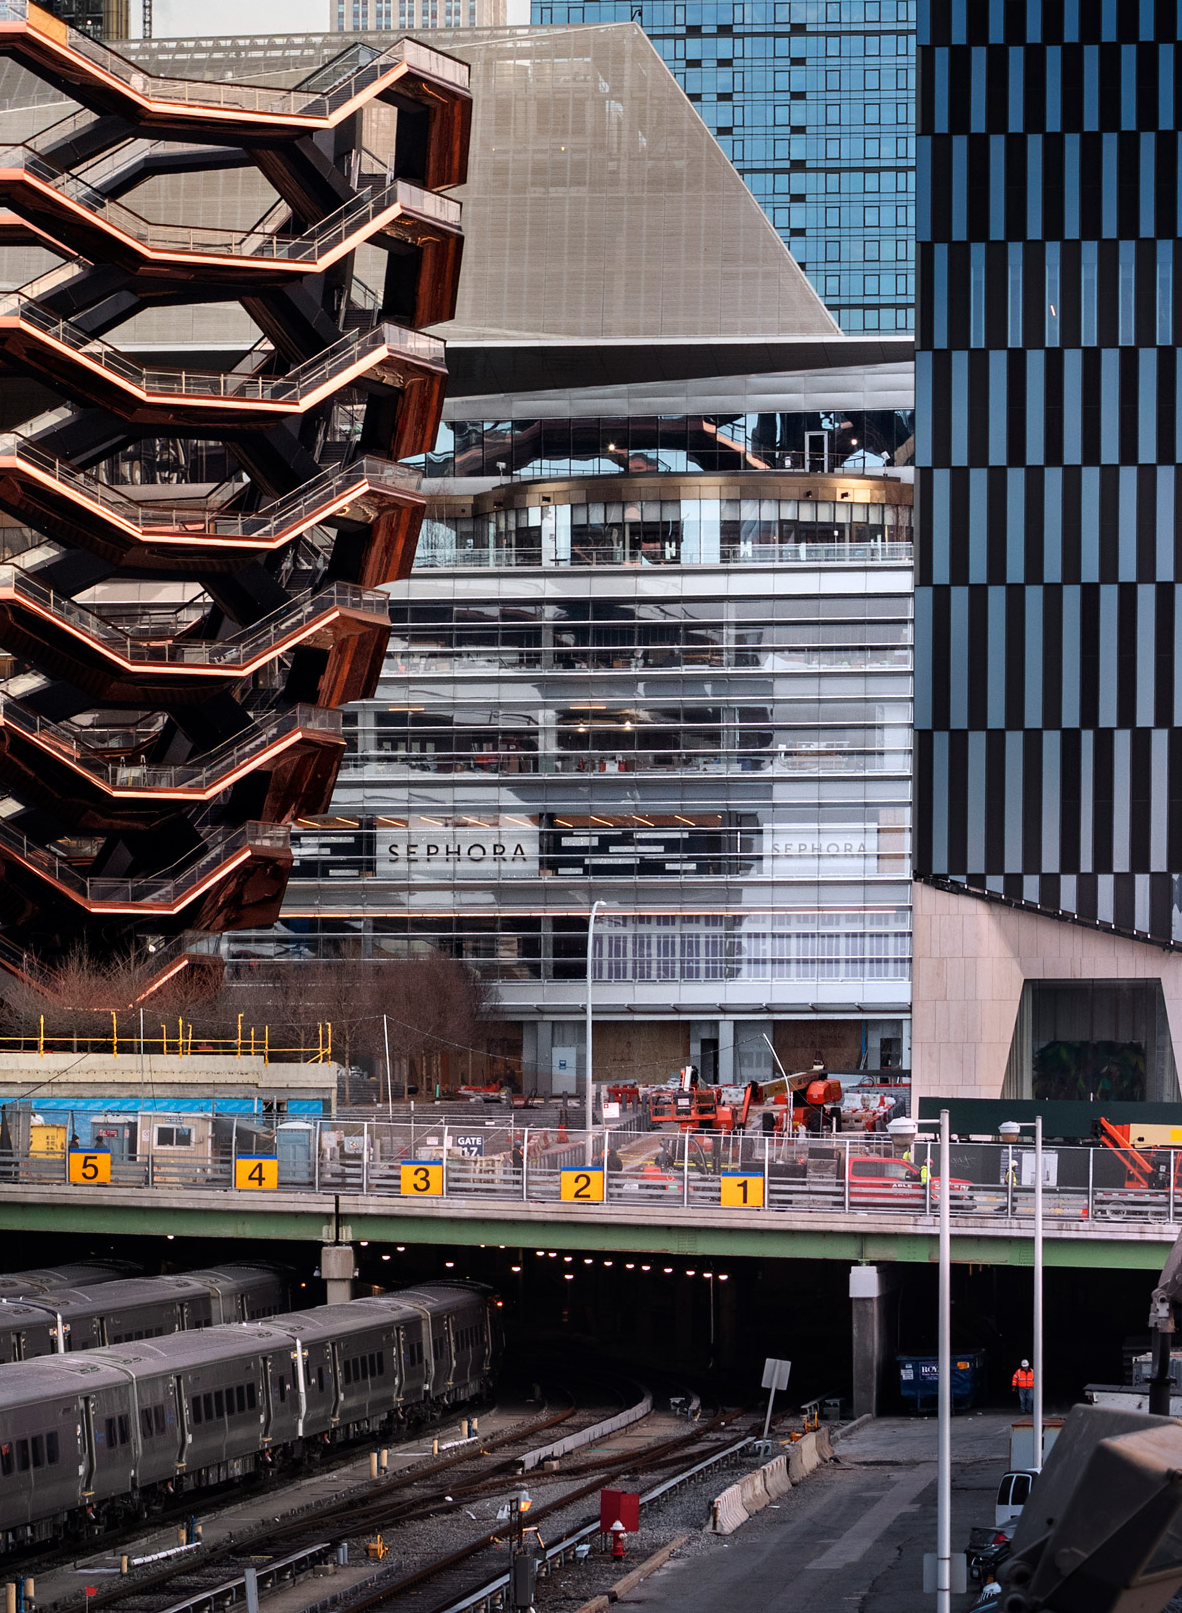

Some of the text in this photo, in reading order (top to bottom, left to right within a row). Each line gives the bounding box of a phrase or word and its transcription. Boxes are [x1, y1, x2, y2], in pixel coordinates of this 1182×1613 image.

[388, 843, 527, 863] SEPHORA
[772, 842, 867, 858] SEPHORA
[458, 1137, 482, 1145] GATE
[462, 1147, 478, 1156] 17
[81, 1156, 99, 1180] 5
[248, 1163, 265, 1186] 4
[413, 1168, 430, 1191] 3
[574, 1174, 590, 1198] 2
[737, 1180, 747, 1203] 1
